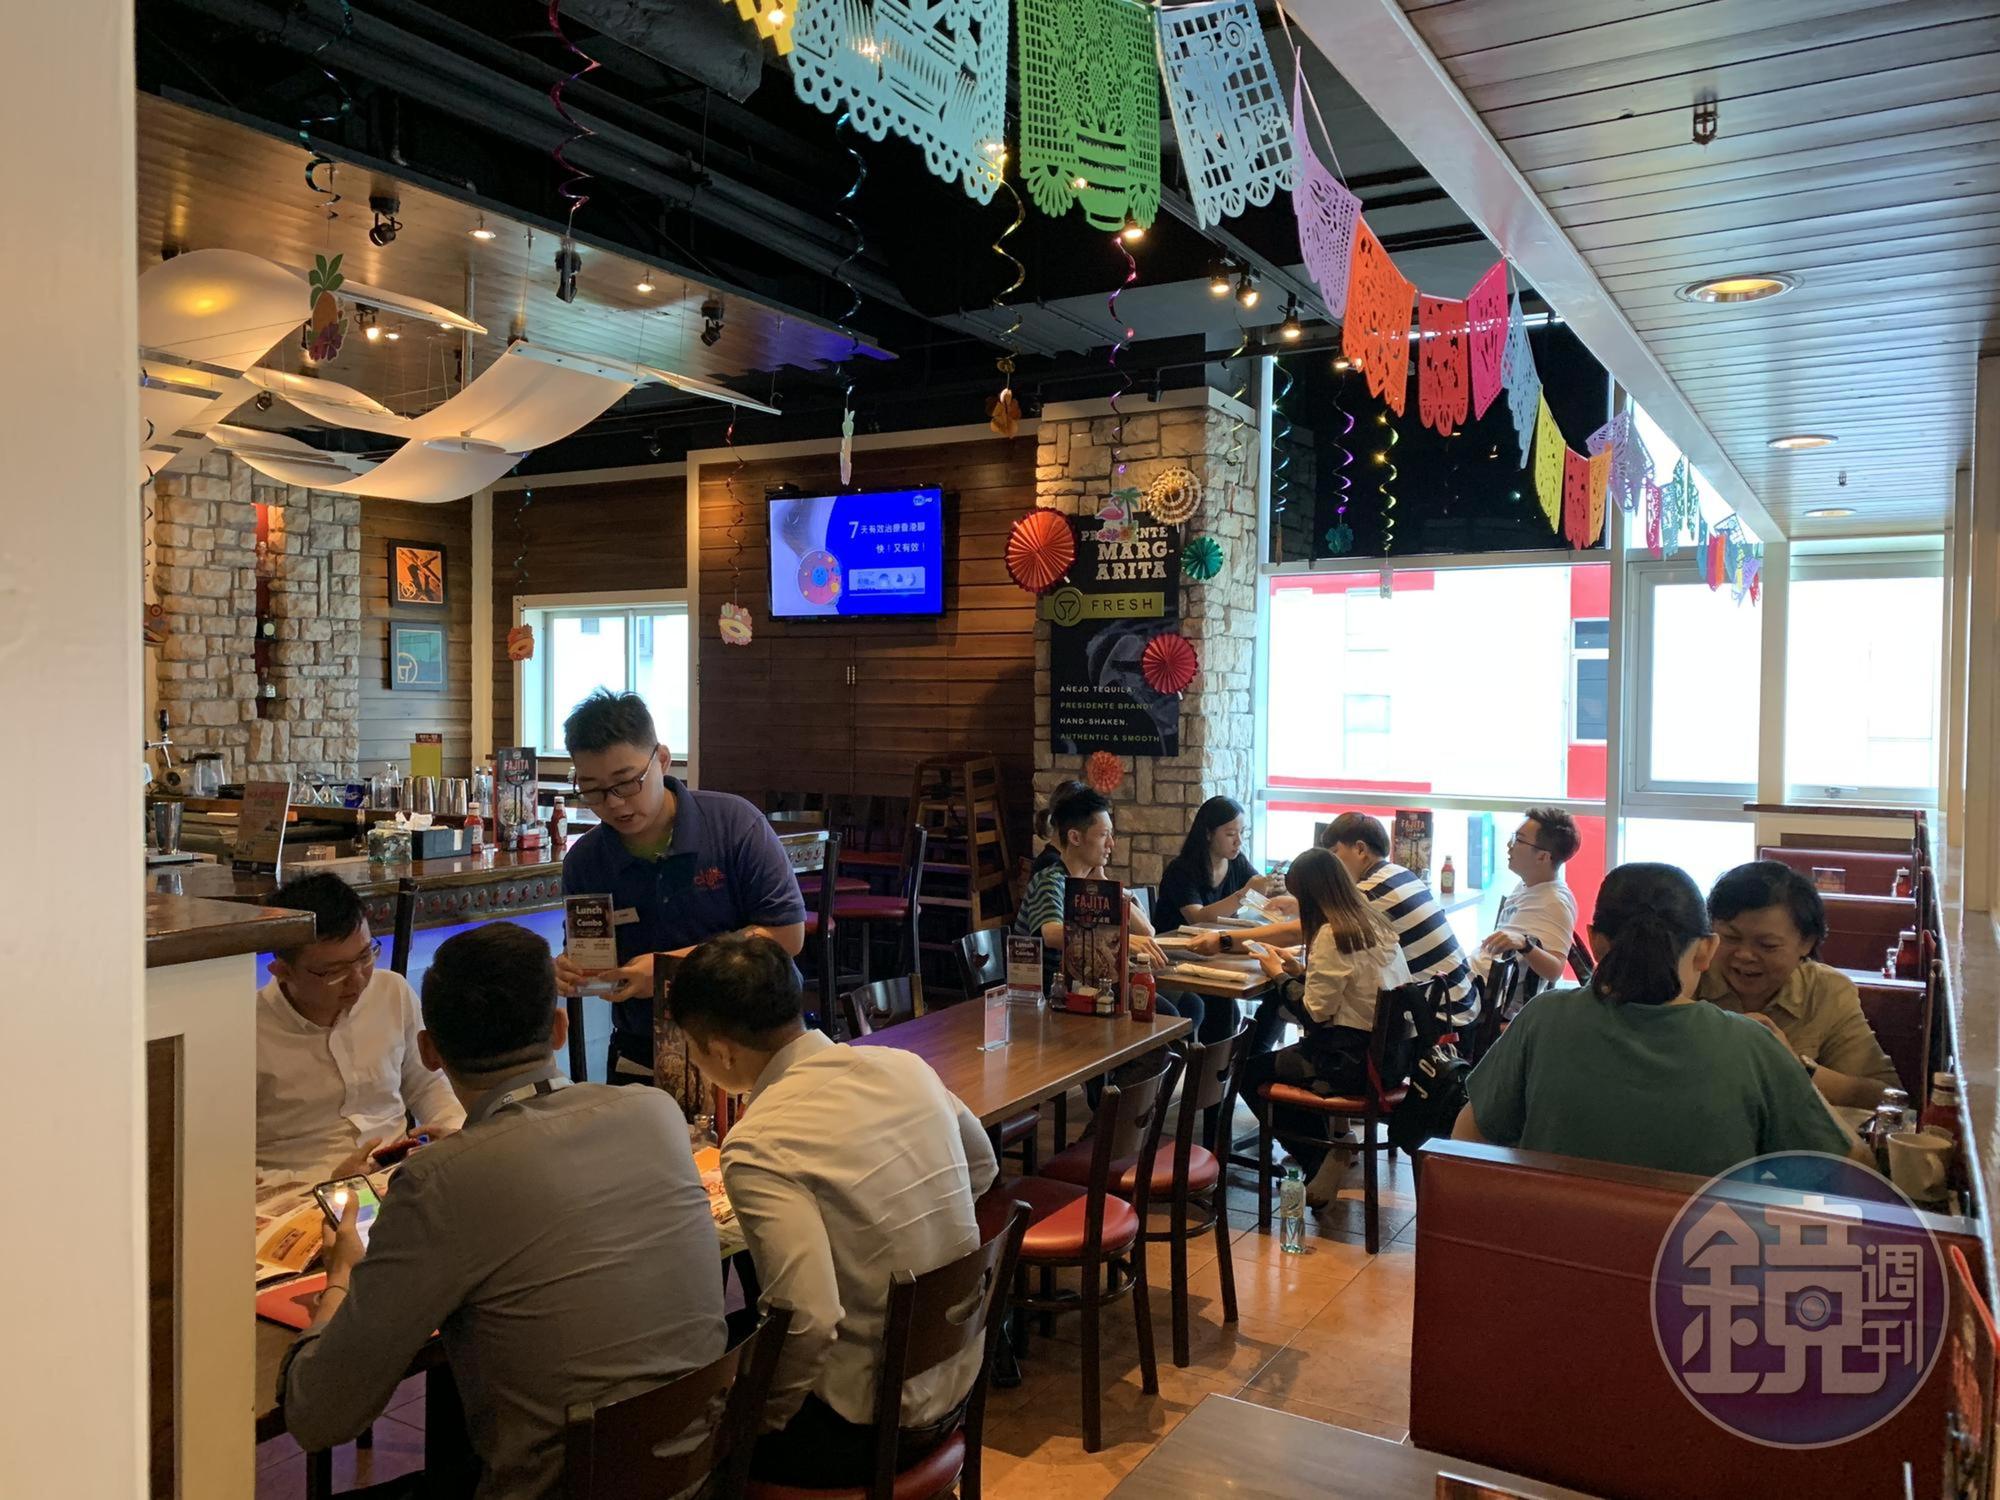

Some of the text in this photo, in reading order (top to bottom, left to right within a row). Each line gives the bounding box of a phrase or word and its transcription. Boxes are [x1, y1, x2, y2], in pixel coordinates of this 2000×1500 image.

[1081, 527, 1168, 542] PRNTE
[1097, 541, 1175, 561] MARG-
[1096, 561, 1168, 581] ARITA
[1092, 598, 1153, 611] FRESH
[1060, 702, 1153, 711] PRESIDENTE BRANDY
[1060, 733, 1110, 741] AUTHENTIC
[1122, 734, 1160, 742] SMOOTH
[504, 759, 529, 771] FAJITA
[1074, 894, 1110, 910] FAJITA
[576, 905, 602, 915] Lunch
[576, 919, 603, 927] Combo
